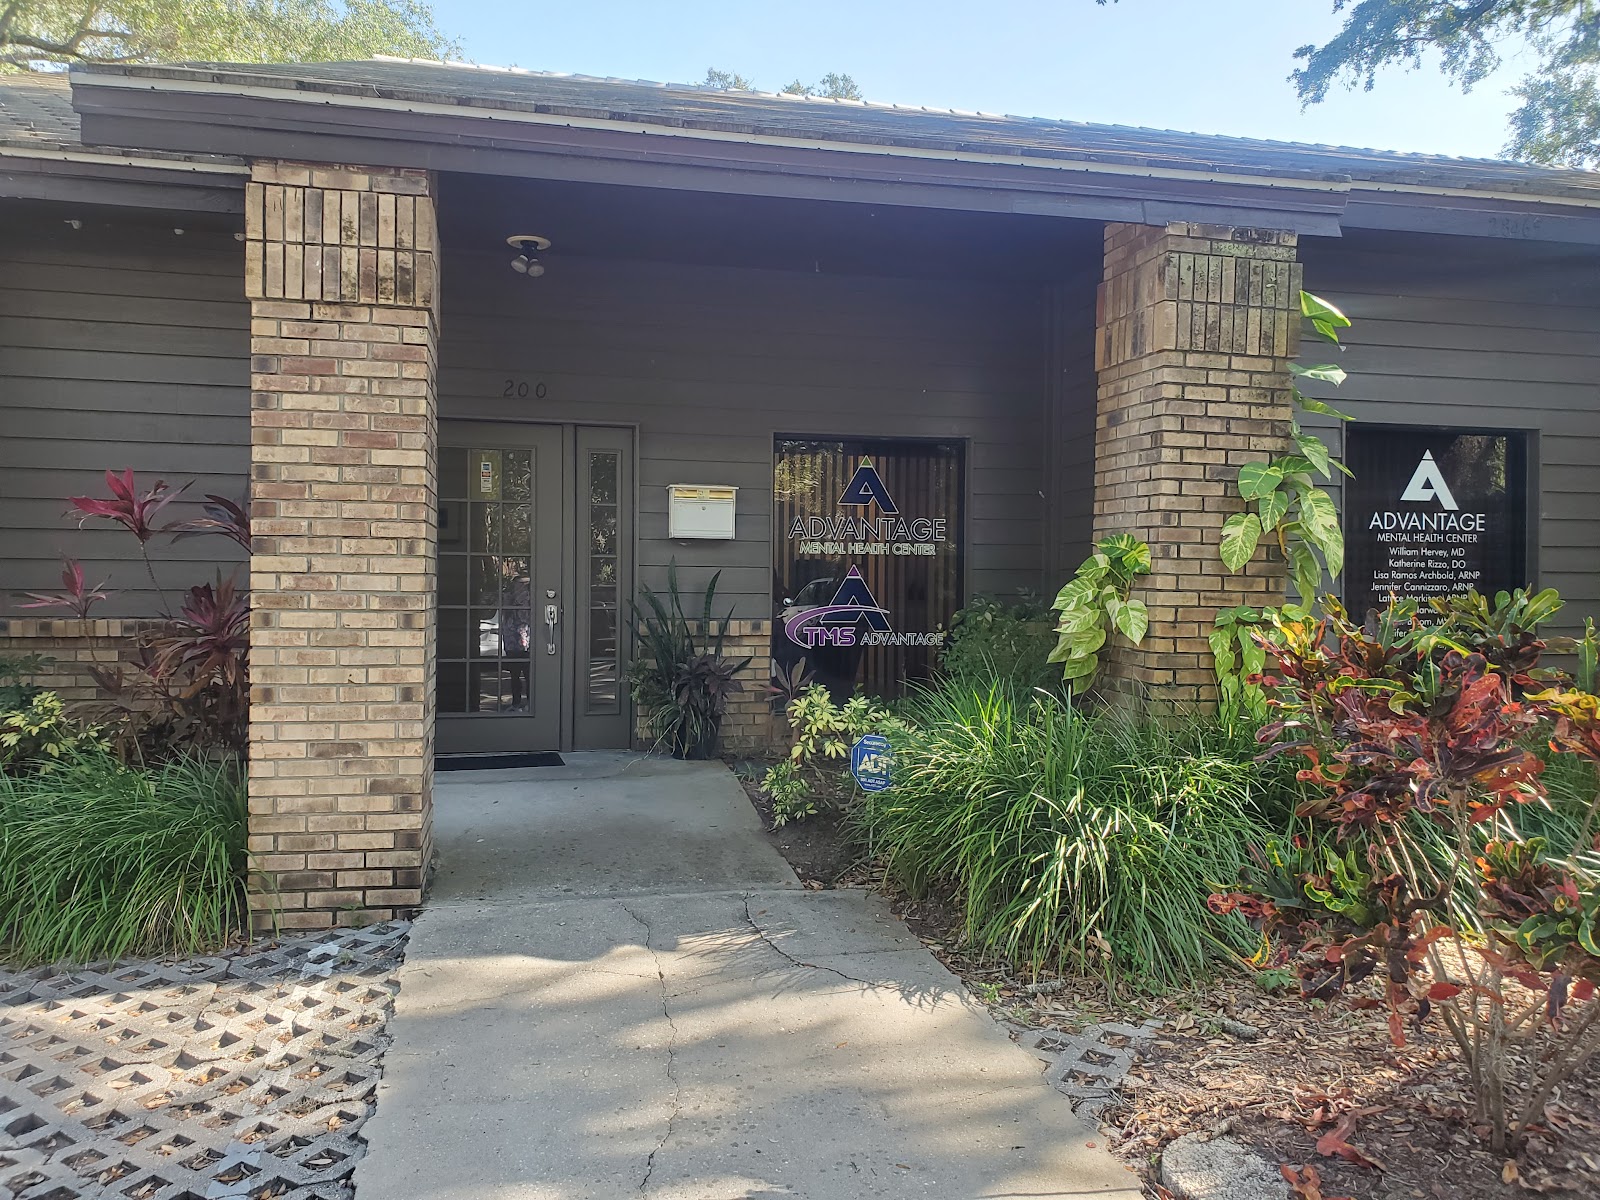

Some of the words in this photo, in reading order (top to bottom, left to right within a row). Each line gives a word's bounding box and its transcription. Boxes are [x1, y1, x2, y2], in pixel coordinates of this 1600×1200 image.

[503, 379, 547, 399] 200
[788, 515, 946, 541] ADVANTAGE
[1369, 512, 1486, 532] ADVANTAGE
[1377, 533, 1411, 542] MENTAL
[1413, 534, 1444, 543] HEALTH
[1445, 534, 1478, 543] CENTER
[799, 541, 846, 555] MENTAL
[848, 543, 890, 556] HEALTH
[891, 543, 936, 556] CENTER
[1389, 547, 1419, 556] William
[1420, 547, 1449, 558] Hervey,
[1450, 547, 1465, 557] MD
[1388, 559, 1426, 568] Katherine
[1427, 559, 1450, 569] Rizzo,
[1451, 559, 1466, 569] DO
[1373, 570, 1389, 579] Lisa
[1391, 571, 1417, 580] Ramos
[1419, 570, 1456, 581] Archbold,
[1458, 571, 1480, 580] ARNP
[1371, 582, 1402, 591] Jennifer
[1403, 582, 1450, 592] Cannizzaro,
[1452, 583, 1474, 592] ARNP
[803, 627, 856, 647] TMS
[860, 632, 944, 647] ADVANTAGE
[858, 753, 890, 775] ADT
